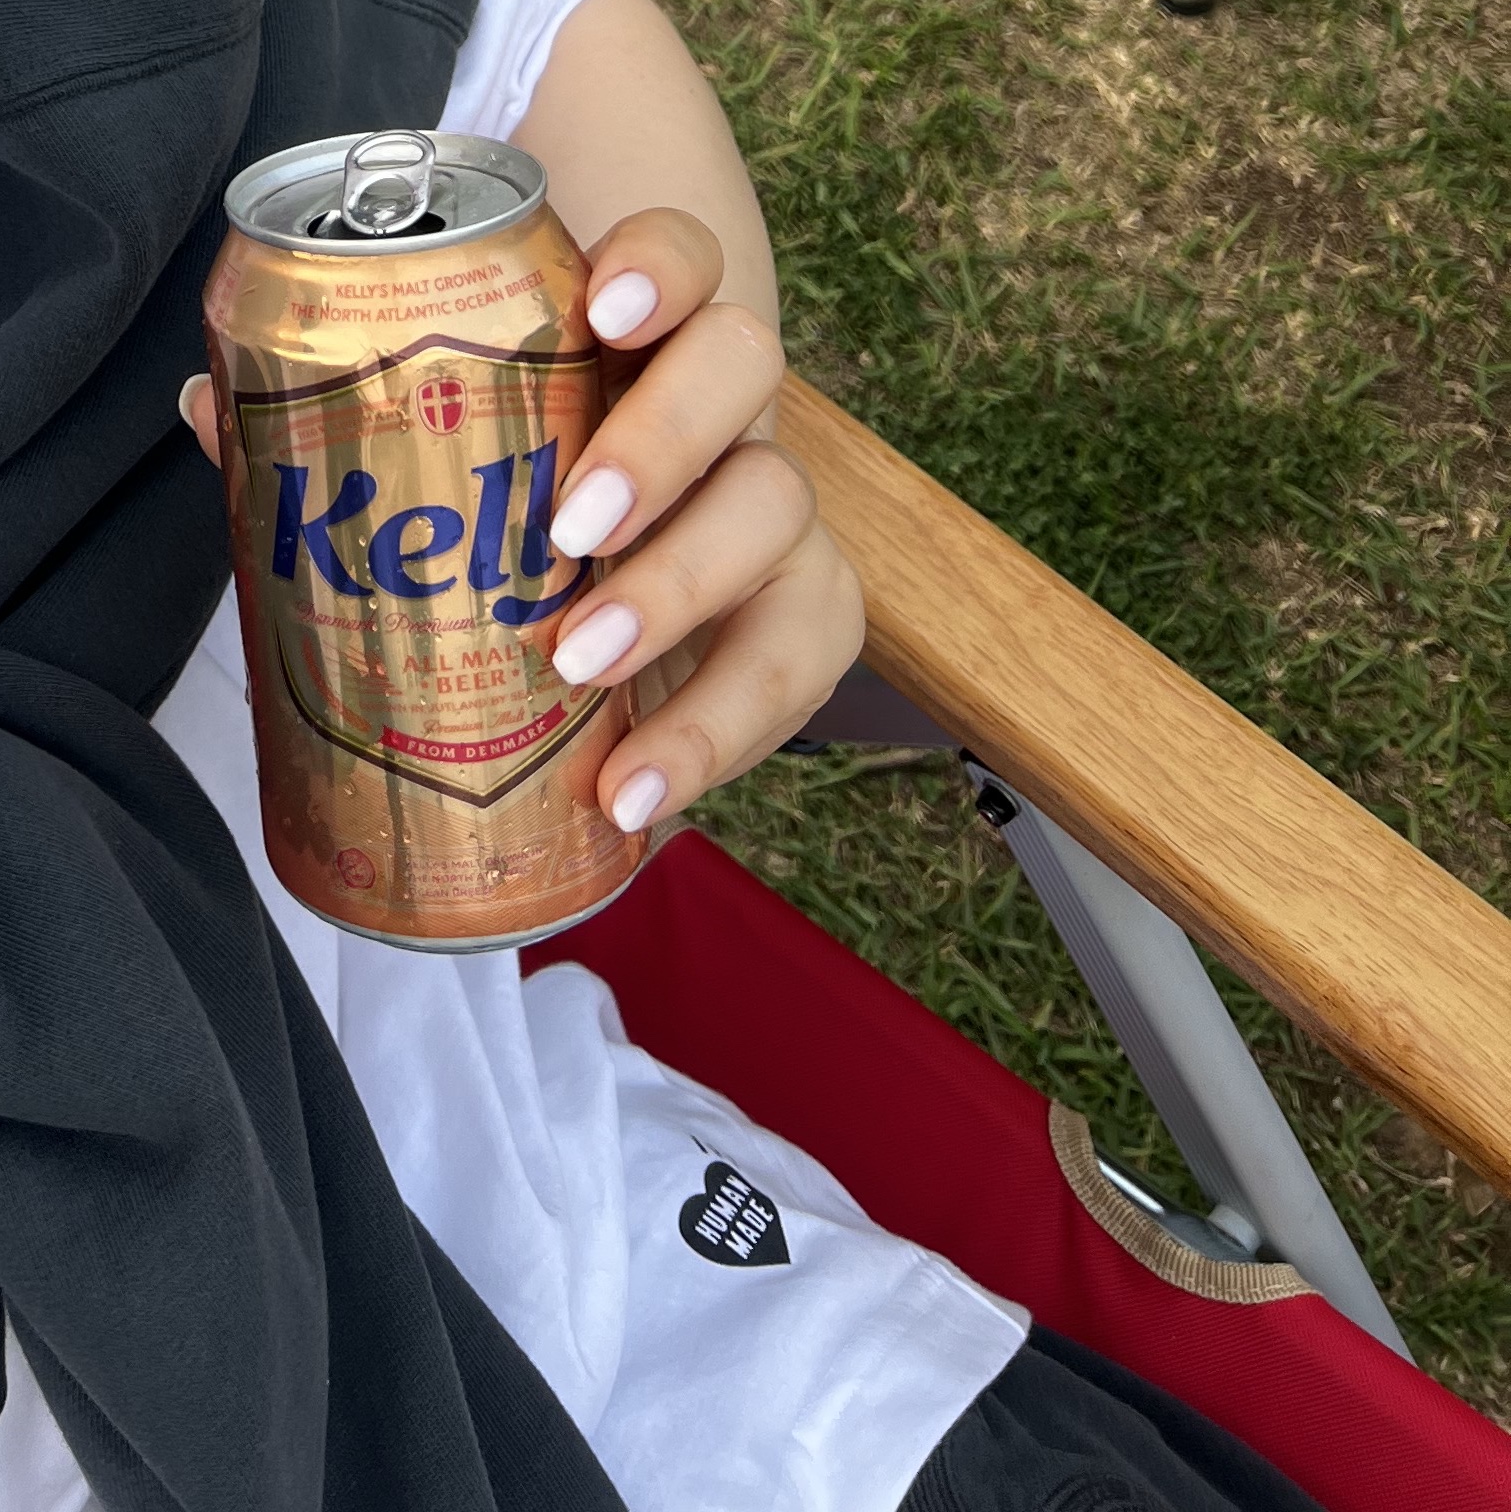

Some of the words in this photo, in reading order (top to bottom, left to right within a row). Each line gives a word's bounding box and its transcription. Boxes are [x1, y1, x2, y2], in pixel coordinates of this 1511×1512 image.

[335, 283, 388, 299] KELLY'S
[392, 279, 429, 296] MALT
[434, 270, 486, 291] GROWN
[488, 263, 503, 278] IN
[291, 302, 314, 319] THE
[320, 304, 371, 322] NORTH
[376, 300, 452, 323] ATLANTIC
[454, 289, 504, 312] OCEAN
[403, 655, 454, 673] ALL
[462, 642, 530, 669] MALT
[438, 668, 506, 694] BEER
[407, 741, 456, 759] FROM
[466, 720, 547, 759] DENMARK
[695, 1175, 752, 1246] HUMAN
[724, 1198, 774, 1259] MADE
